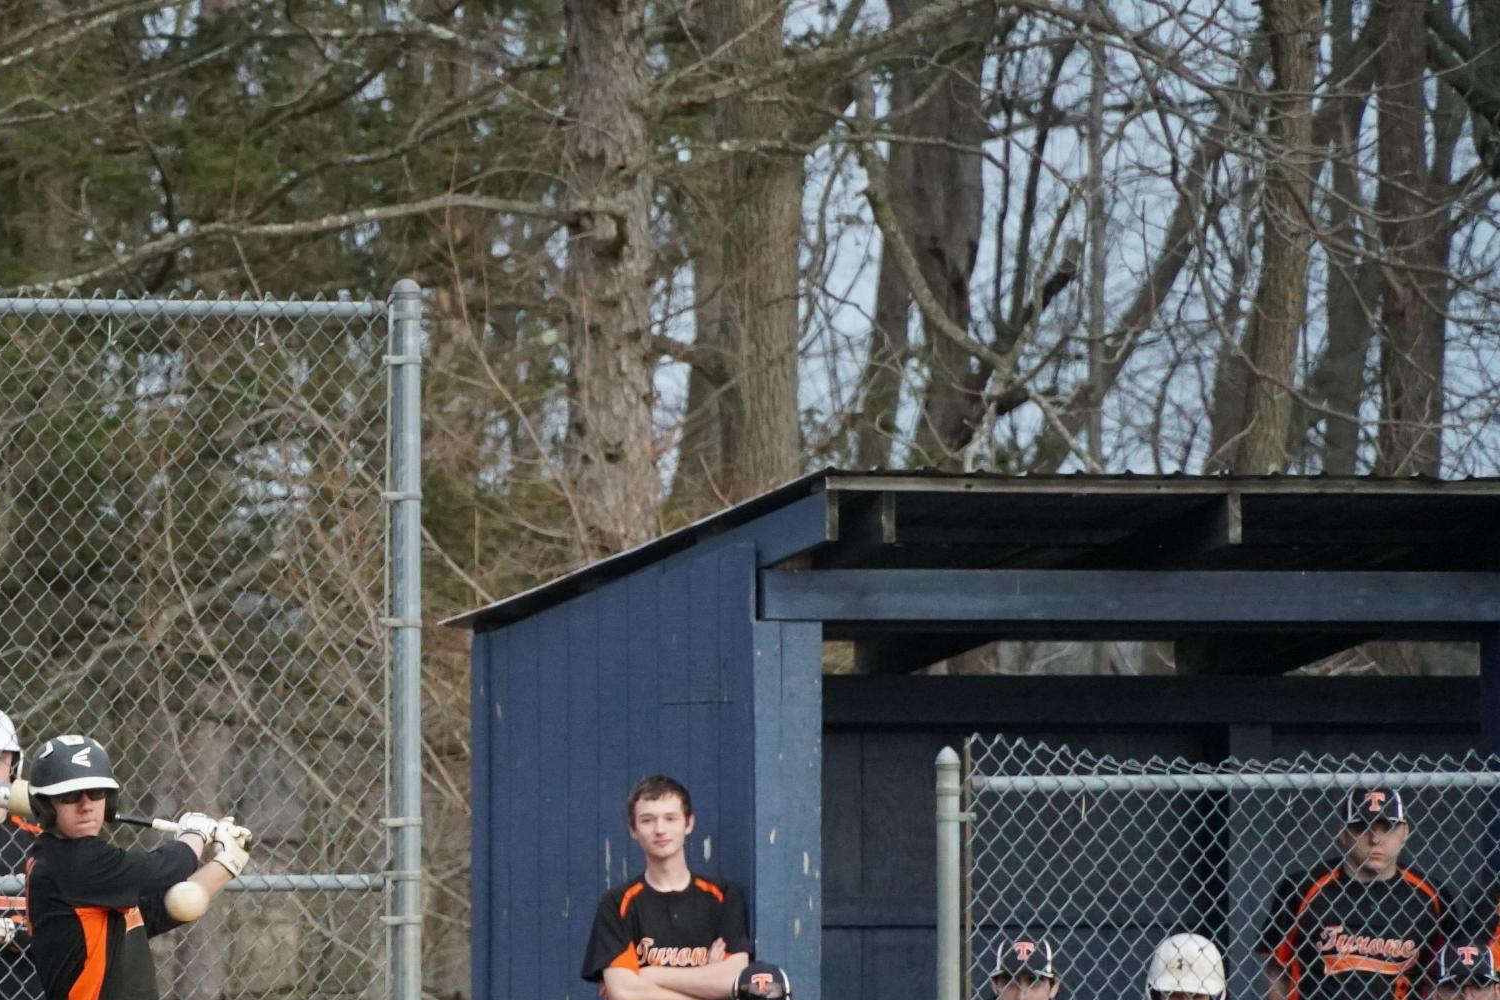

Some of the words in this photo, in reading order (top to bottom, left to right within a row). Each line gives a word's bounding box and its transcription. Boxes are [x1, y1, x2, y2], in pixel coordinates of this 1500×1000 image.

[1364, 791, 1386, 812] T
[636, 937, 710, 967] Tyron
[1012, 941, 1036, 961] T
[1316, 925, 1416, 959] Tyrone
[1457, 946, 1479, 966] T
[751, 973, 773, 993] T
